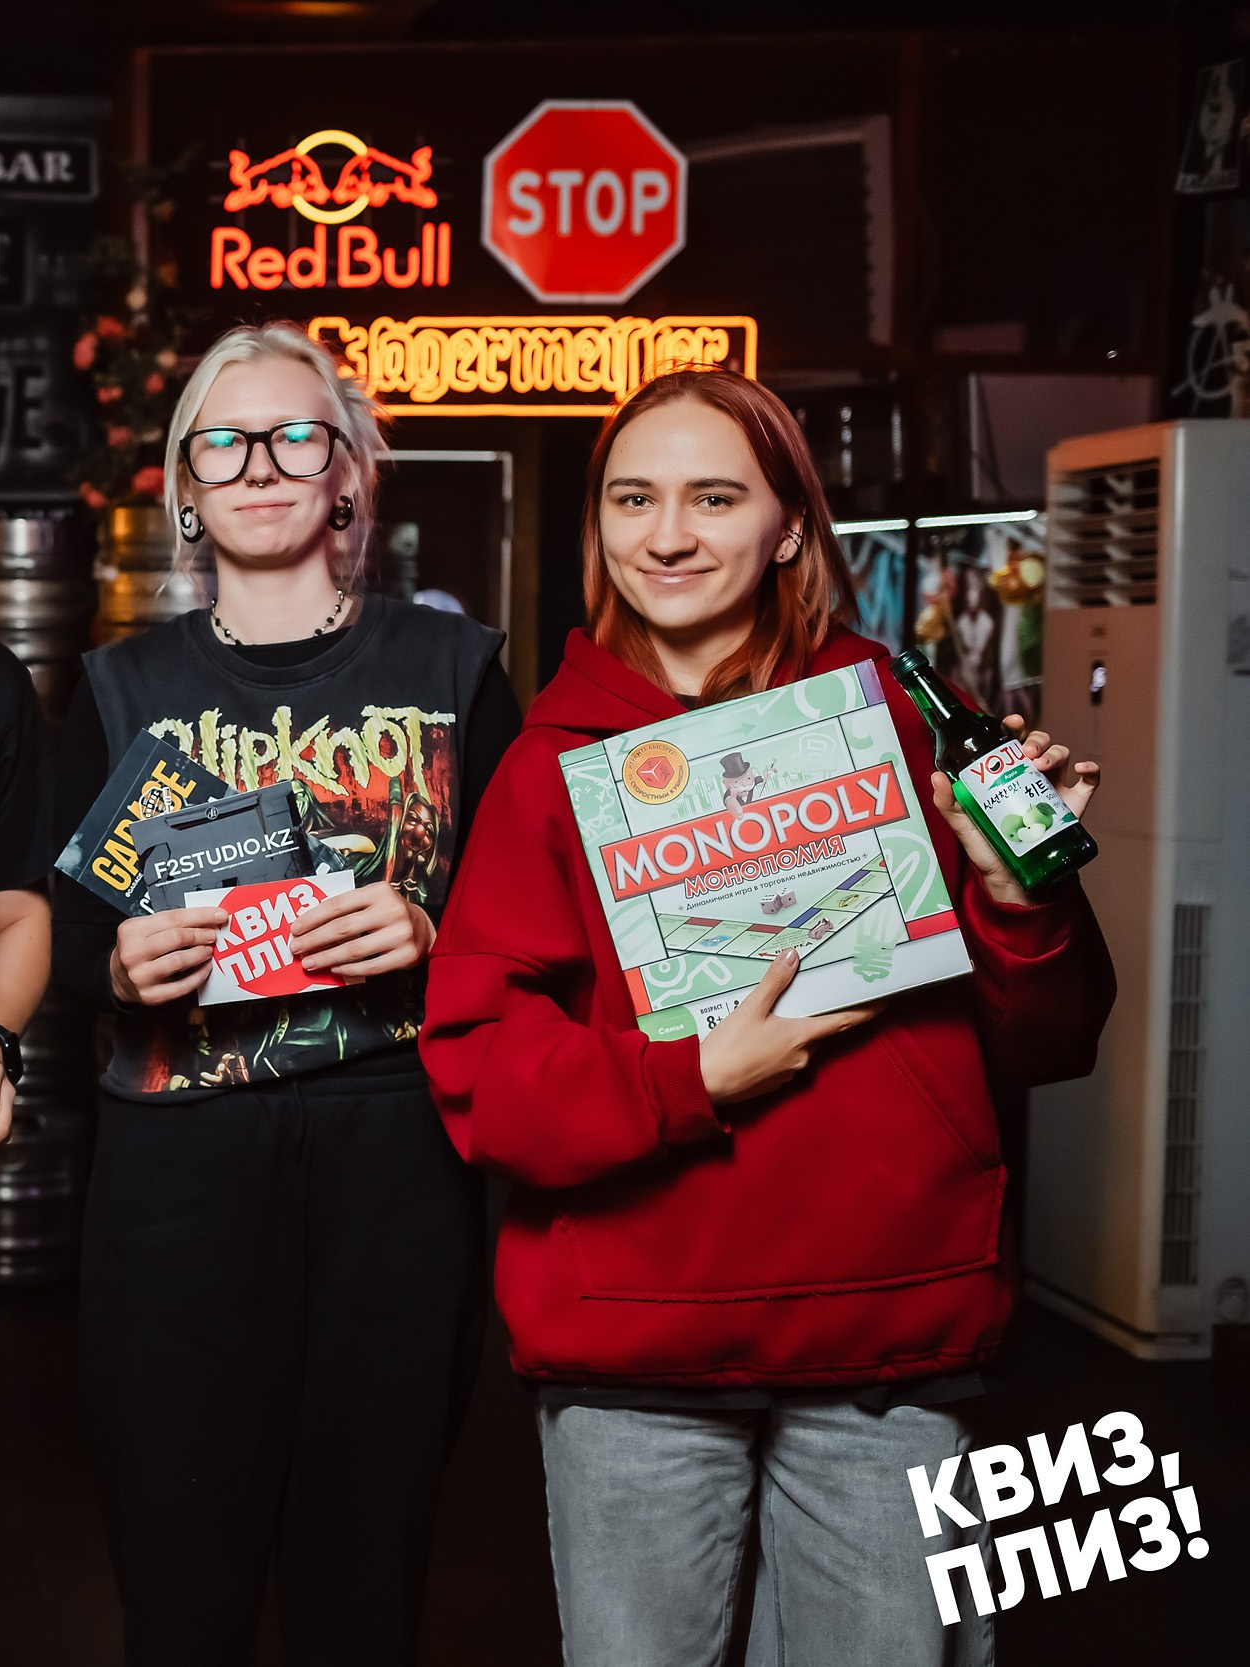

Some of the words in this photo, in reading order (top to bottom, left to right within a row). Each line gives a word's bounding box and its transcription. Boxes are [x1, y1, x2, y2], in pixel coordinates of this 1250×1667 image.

[507, 170, 671, 236] STOP
[209, 223, 327, 289] Red
[338, 222, 450, 289] Bull
[970, 742, 1026, 784] YOJU
[154, 827, 295, 879] F2STUDIO.KZ
[614, 772, 890, 891] MONOPOLY
[683, 834, 847, 899] МОНОПОЛИЯ
[686, 893, 734, 911] Динамичная
[735, 887, 753, 899] игра
[760, 875, 797, 890] торговлю
[797, 857, 862, 879] недвижимостью
[658, 1024, 684, 1035] Семья
[700, 1003, 723, 1014] ВОЗРАСТ
[706, 1015, 723, 1029] 8+
